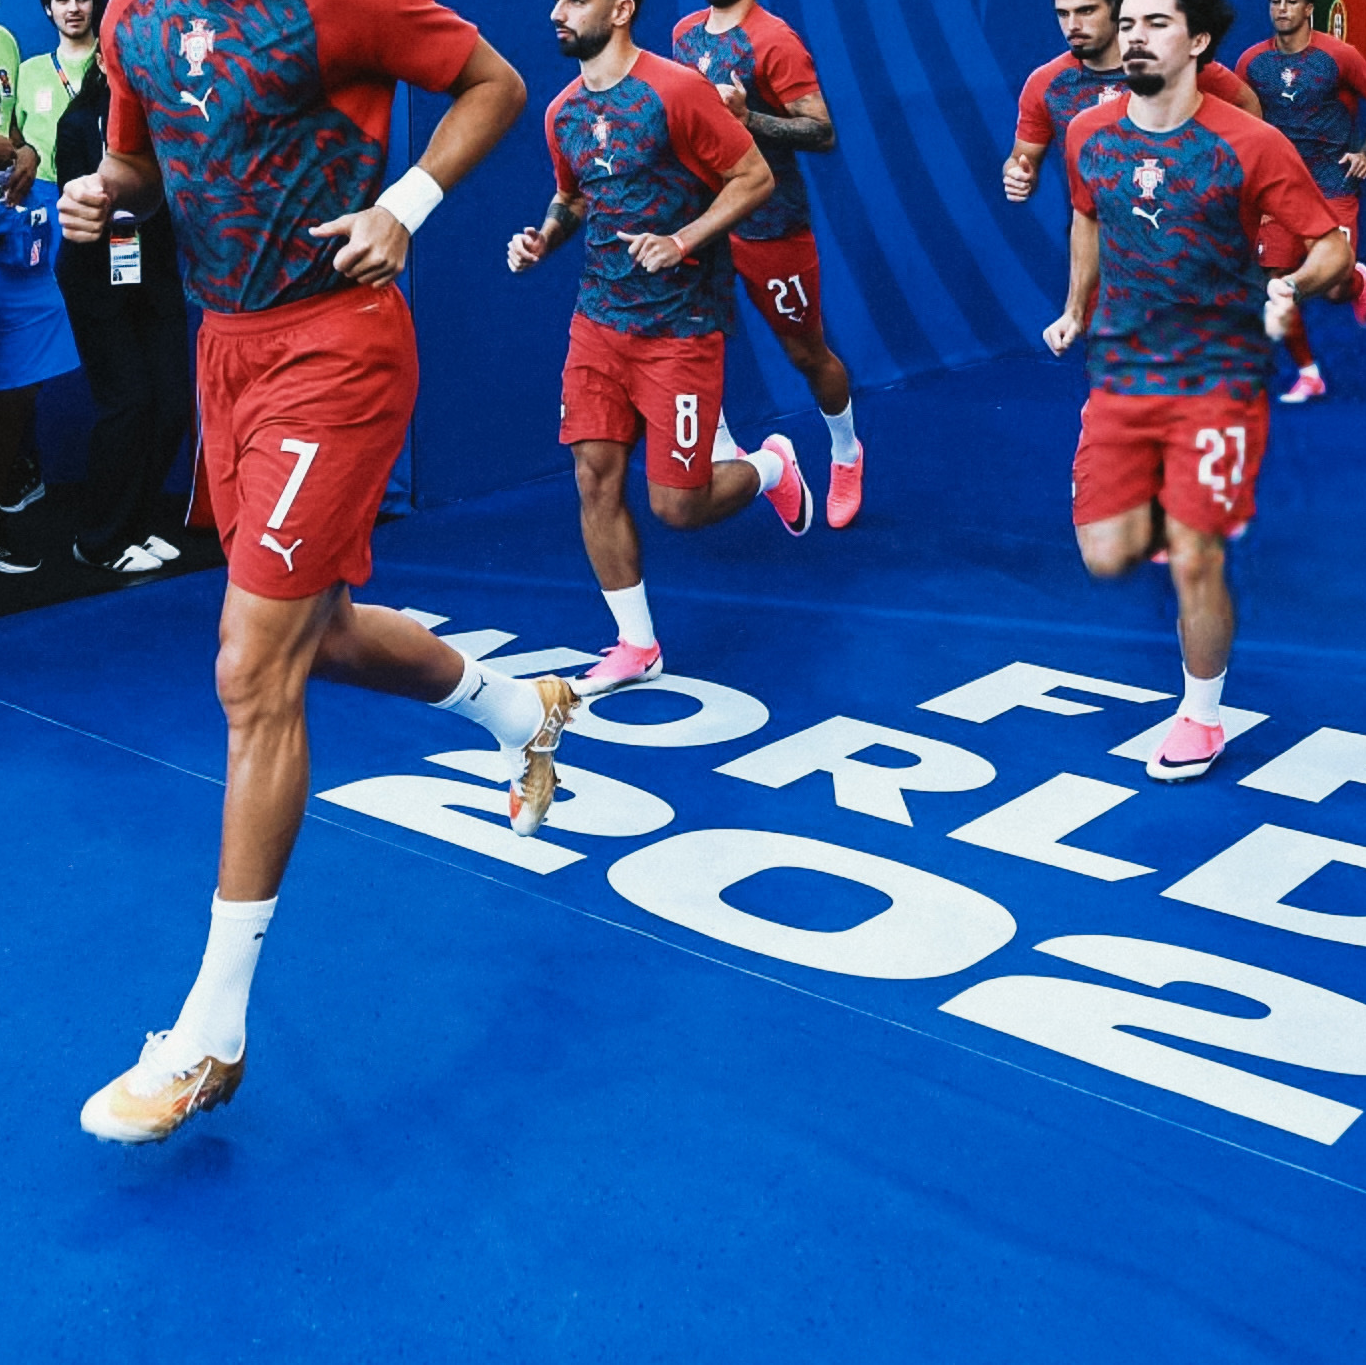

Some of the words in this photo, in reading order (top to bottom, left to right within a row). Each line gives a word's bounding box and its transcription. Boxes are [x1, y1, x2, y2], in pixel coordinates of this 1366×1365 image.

[767, 274, 808, 314] 21
[675, 394, 700, 449] 8
[266, 438, 320, 530] 7
[1195, 426, 1246, 491] 27
